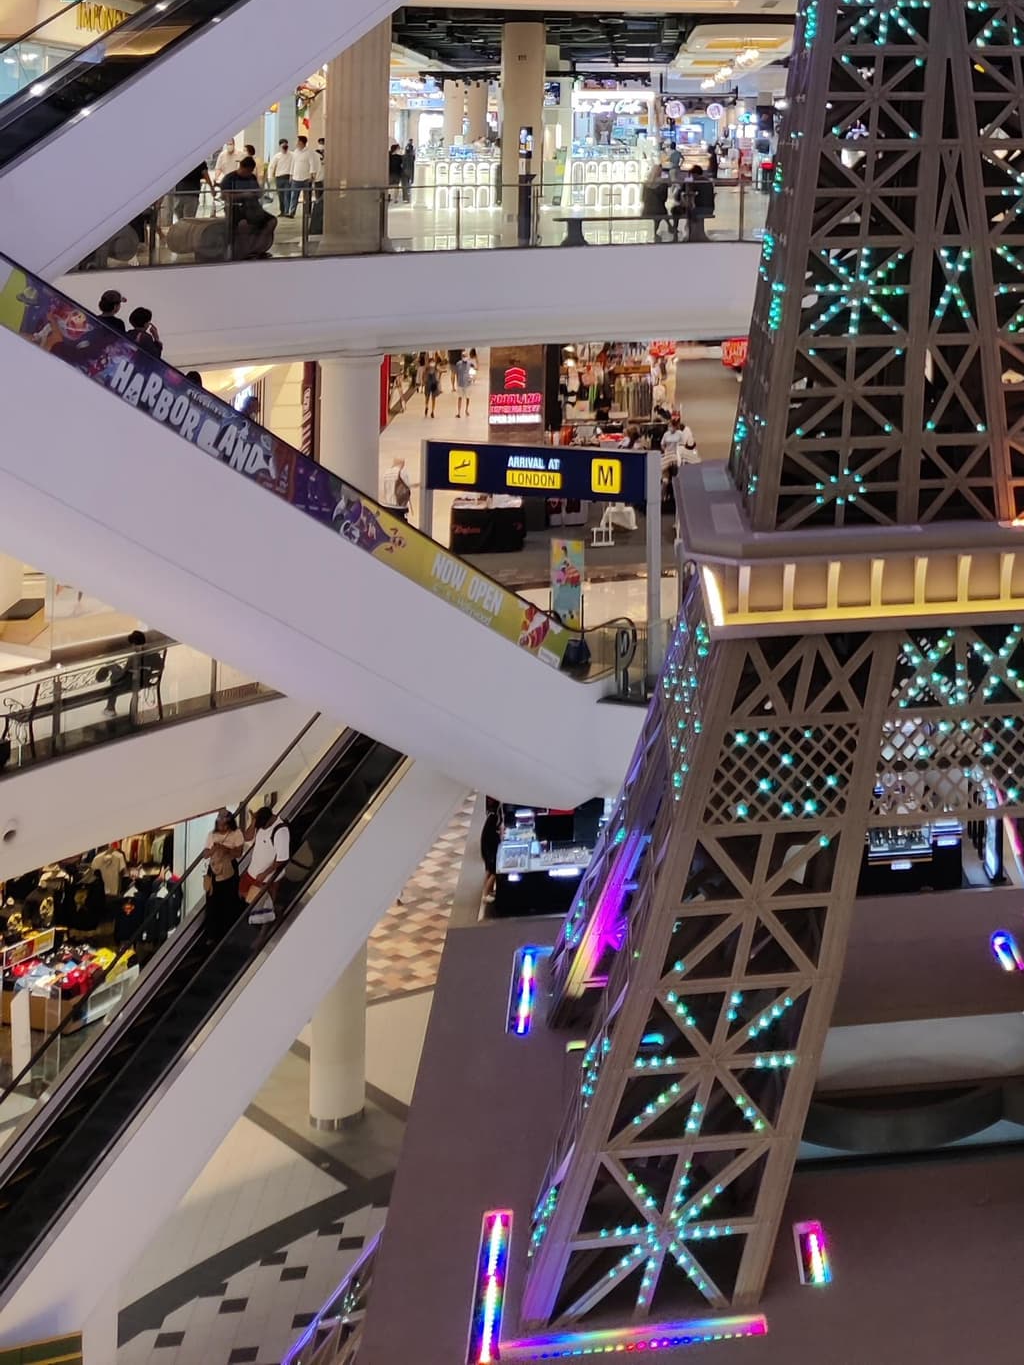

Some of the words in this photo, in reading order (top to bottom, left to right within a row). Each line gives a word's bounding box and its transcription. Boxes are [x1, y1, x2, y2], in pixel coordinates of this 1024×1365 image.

[508, 455, 545, 470] ARRIVAL
[548, 458, 560, 470] AT
[511, 472, 556, 487] LONDON
[597, 465, 614, 487] M
[431, 552, 468, 591] NOW
[467, 576, 505, 616] OPEN
